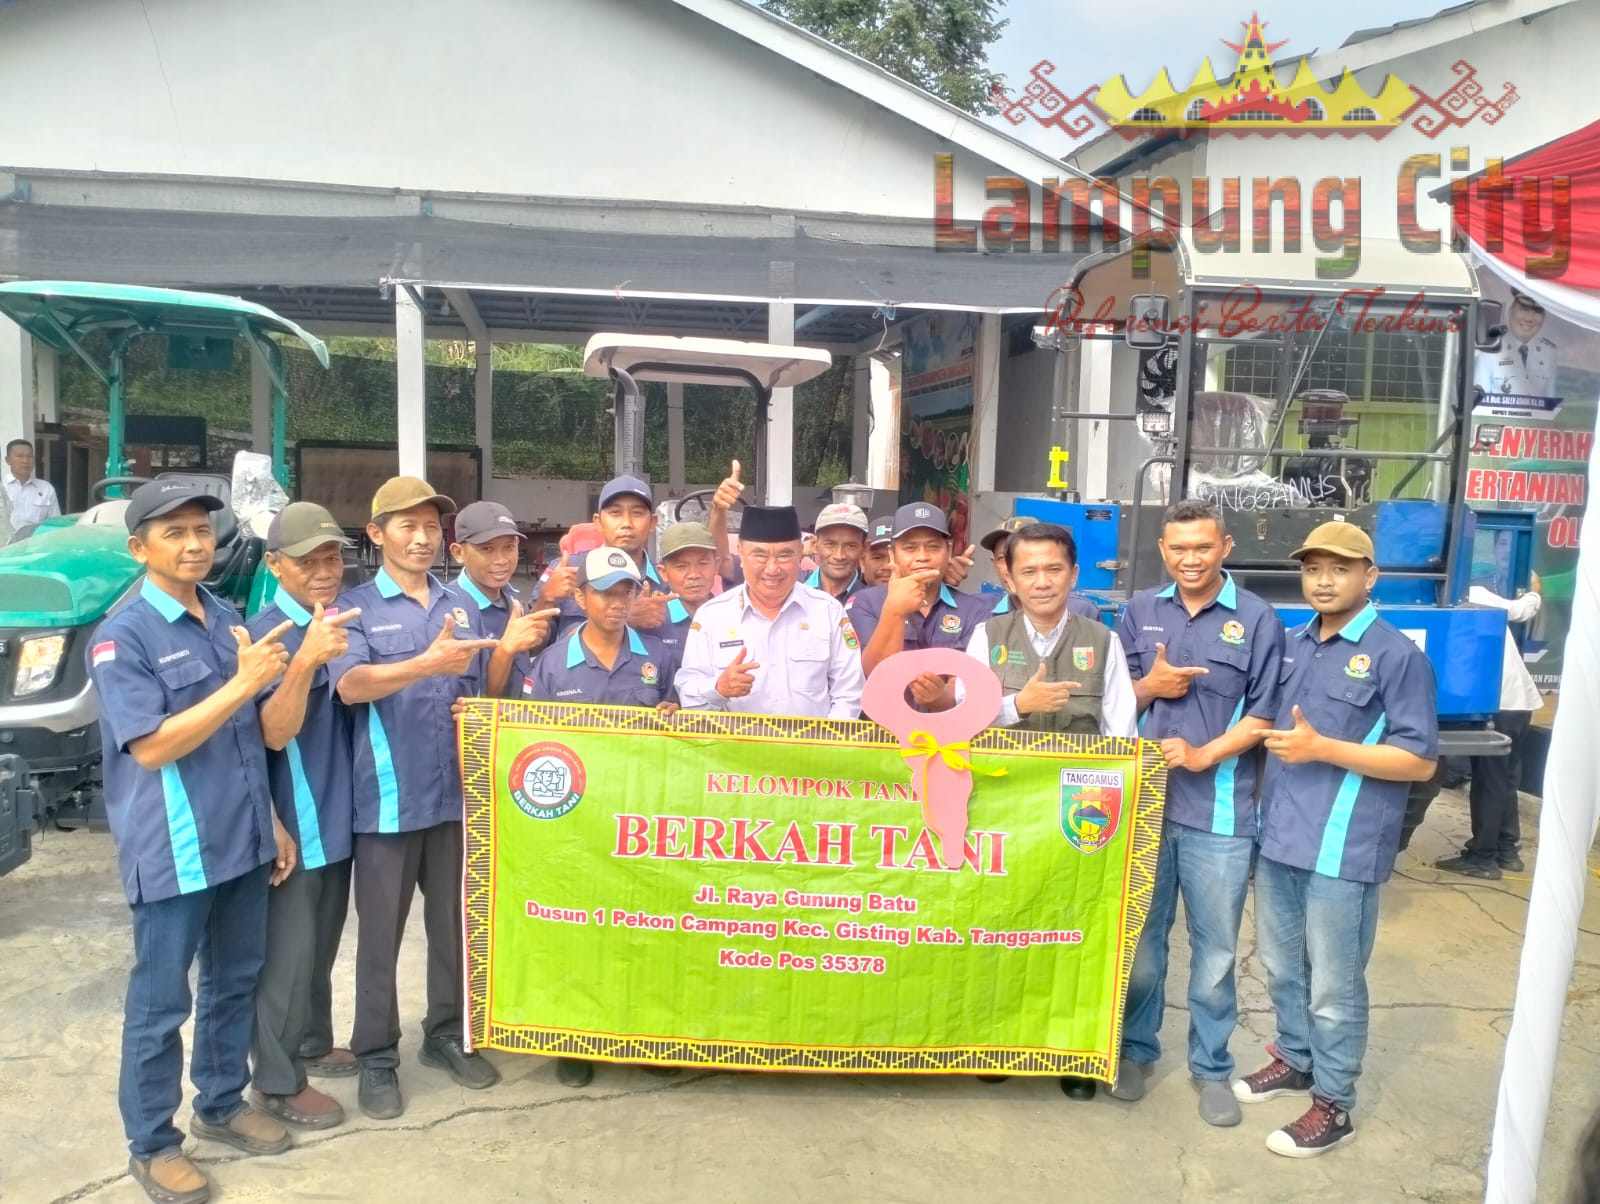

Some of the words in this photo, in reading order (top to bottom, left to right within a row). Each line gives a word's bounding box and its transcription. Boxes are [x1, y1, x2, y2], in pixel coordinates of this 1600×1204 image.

[706, 772, 854, 799] KELOMPOK
[1065, 772, 1120, 786] TANGGAMUS
[513, 790, 554, 818] BERKAH
[555, 793, 581, 817] TANI
[612, 813, 857, 867] BERKAH
[870, 825, 1009, 877] TANI
[694, 886, 721, 904] Jl.
[726, 887, 778, 909] Raya
[783, 889, 863, 914] Gunung
[867, 893, 918, 913] Batu
[526, 900, 588, 924] Dusun
[593, 907, 606, 925] 1
[612, 909, 676, 930] Pekon
[680, 914, 779, 939] Campang
[782, 919, 829, 938] Kec.
[835, 921, 911, 946] Gisting
[915, 926, 965, 945] Kab.
[969, 928, 1083, 949] Tanggamus
[719, 949, 773, 969] Kode
[778, 952, 816, 970] Pos
[821, 954, 887, 975] 35378
